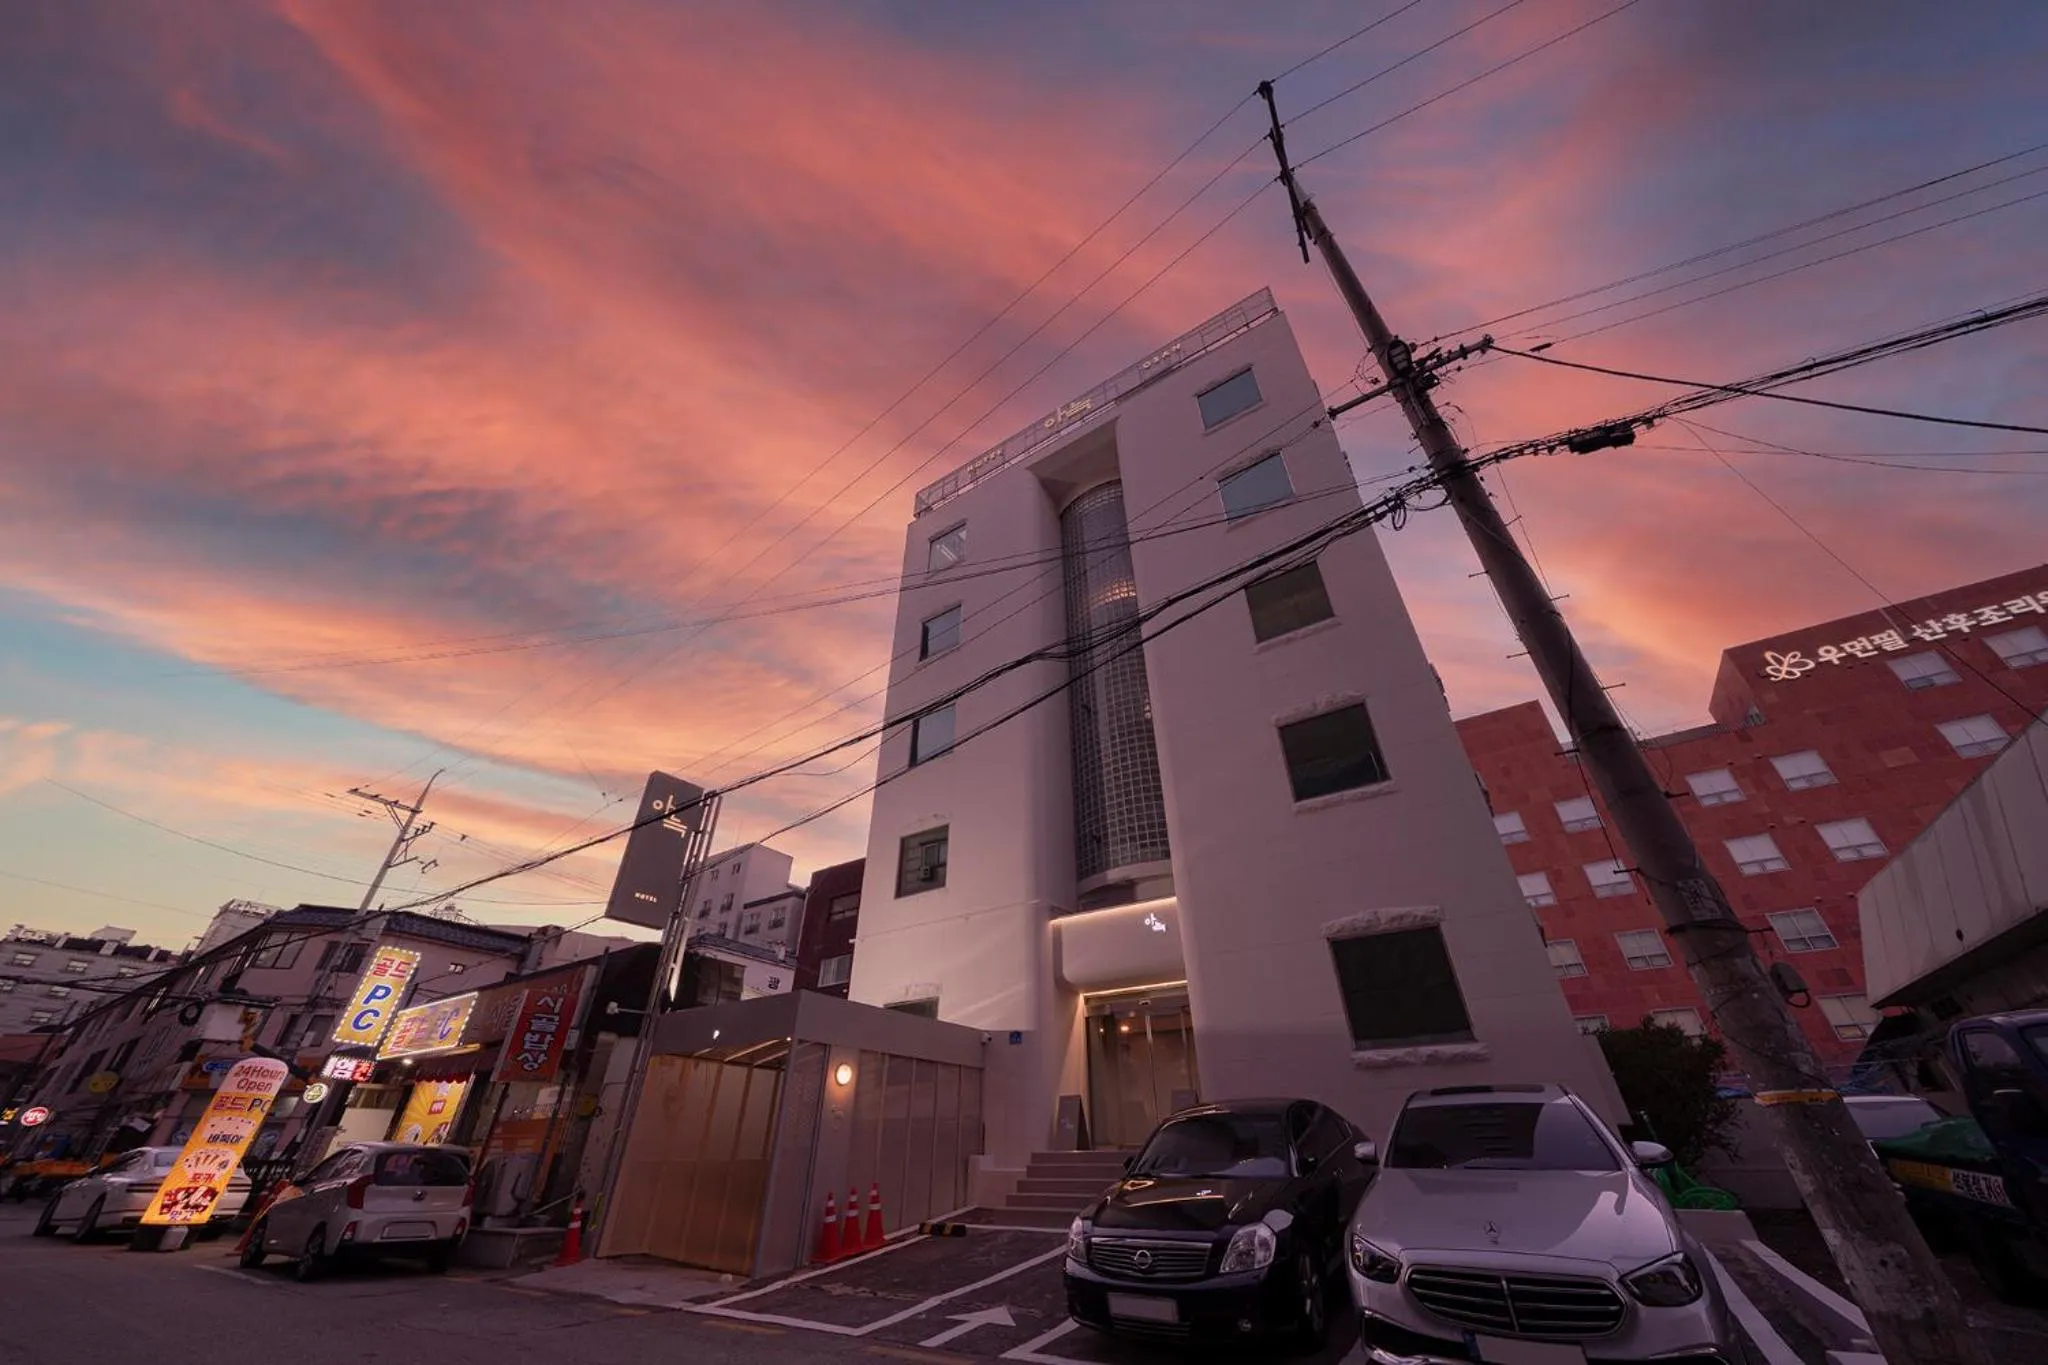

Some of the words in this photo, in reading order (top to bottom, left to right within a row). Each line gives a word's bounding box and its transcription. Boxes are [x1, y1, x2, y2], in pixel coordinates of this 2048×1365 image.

[1818, 629, 1909, 665] 우먼필
[371, 957, 412, 979] 골드
[352, 984, 392, 1031] PC
[237, 1078, 273, 1093] Open
